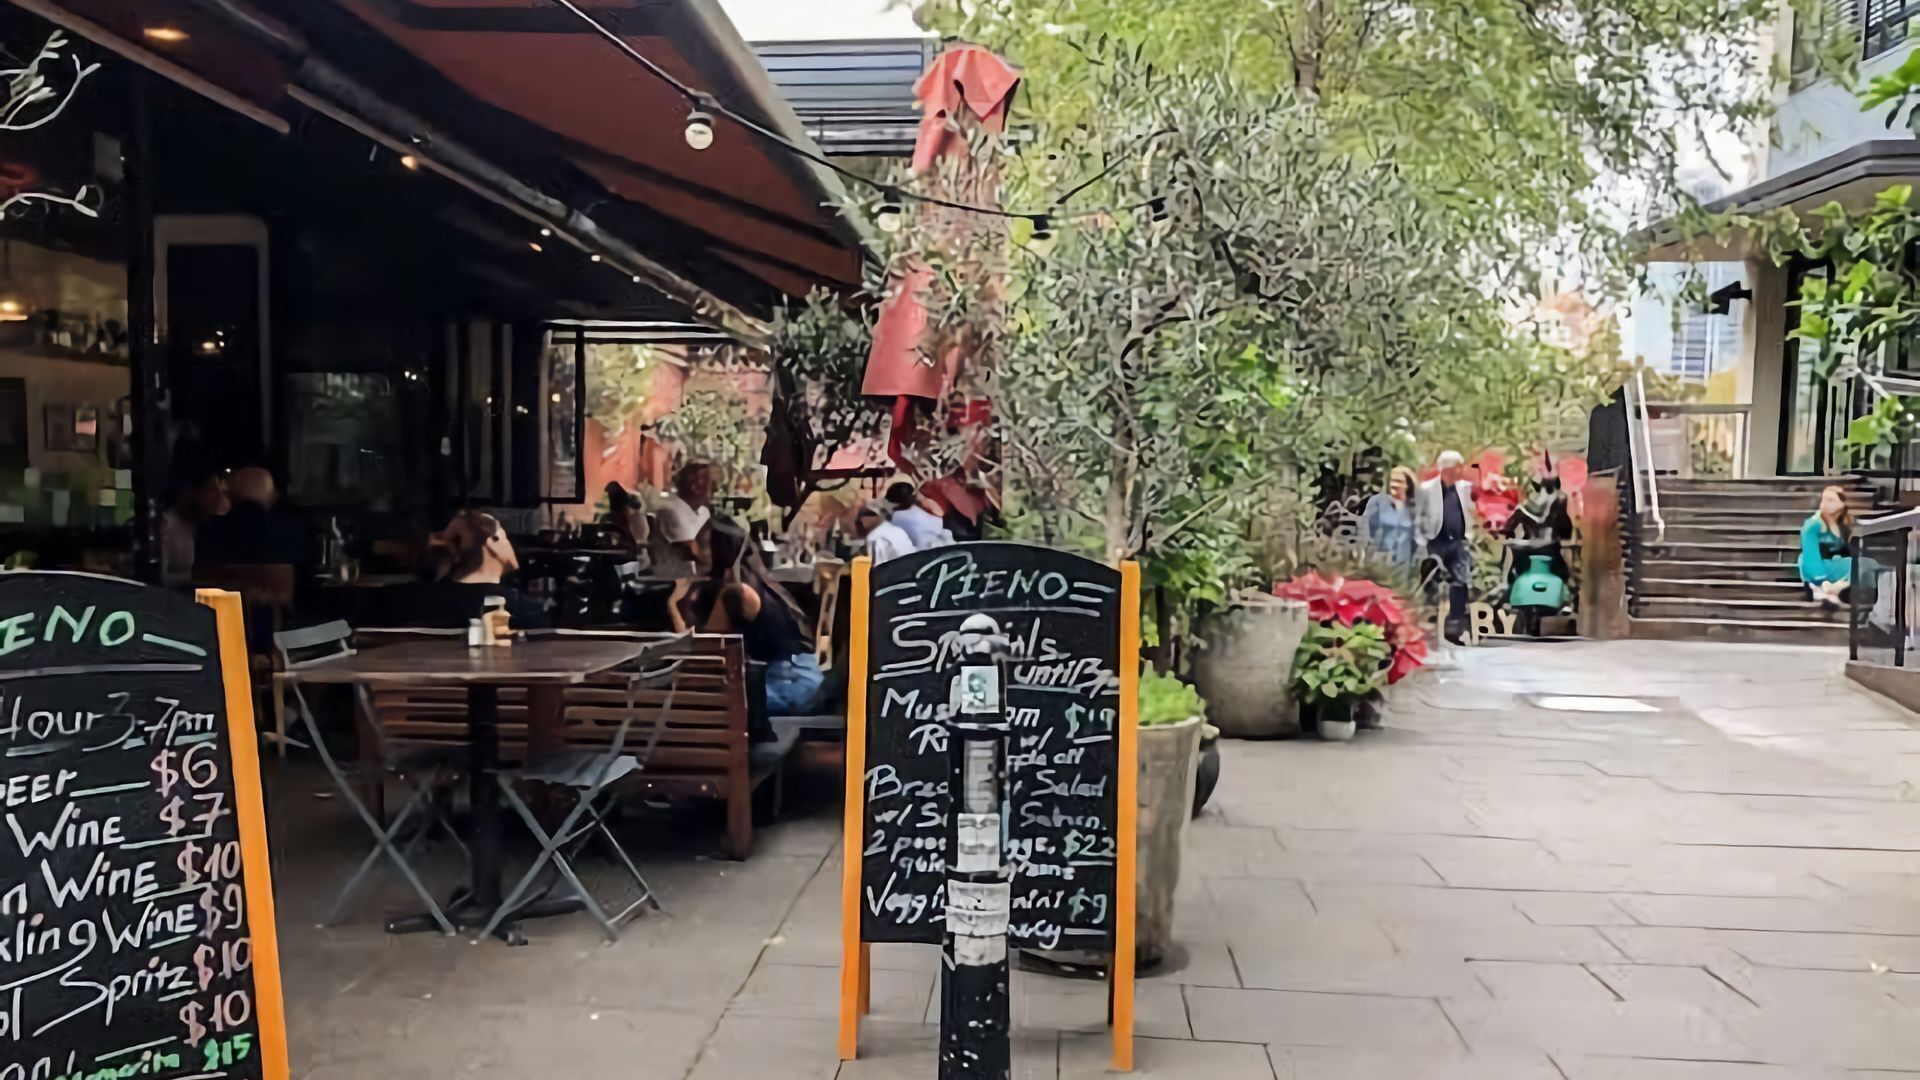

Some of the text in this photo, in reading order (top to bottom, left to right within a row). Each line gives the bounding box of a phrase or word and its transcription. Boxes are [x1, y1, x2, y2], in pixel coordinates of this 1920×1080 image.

[916, 551, 1069, 608] PIENO
[881, 687, 1040, 727] Musom
[151, 742, 218, 798] $6
[159, 792, 231, 837] $7
[177, 840, 240, 886] $10
[864, 829, 888, 857] 2
[1063, 829, 1117, 858] $22
[198, 882, 243, 940] $9
[32, 956, 194, 1037] Spritz
[193, 937, 251, 991] $10
[179, 989, 250, 1048] $10
